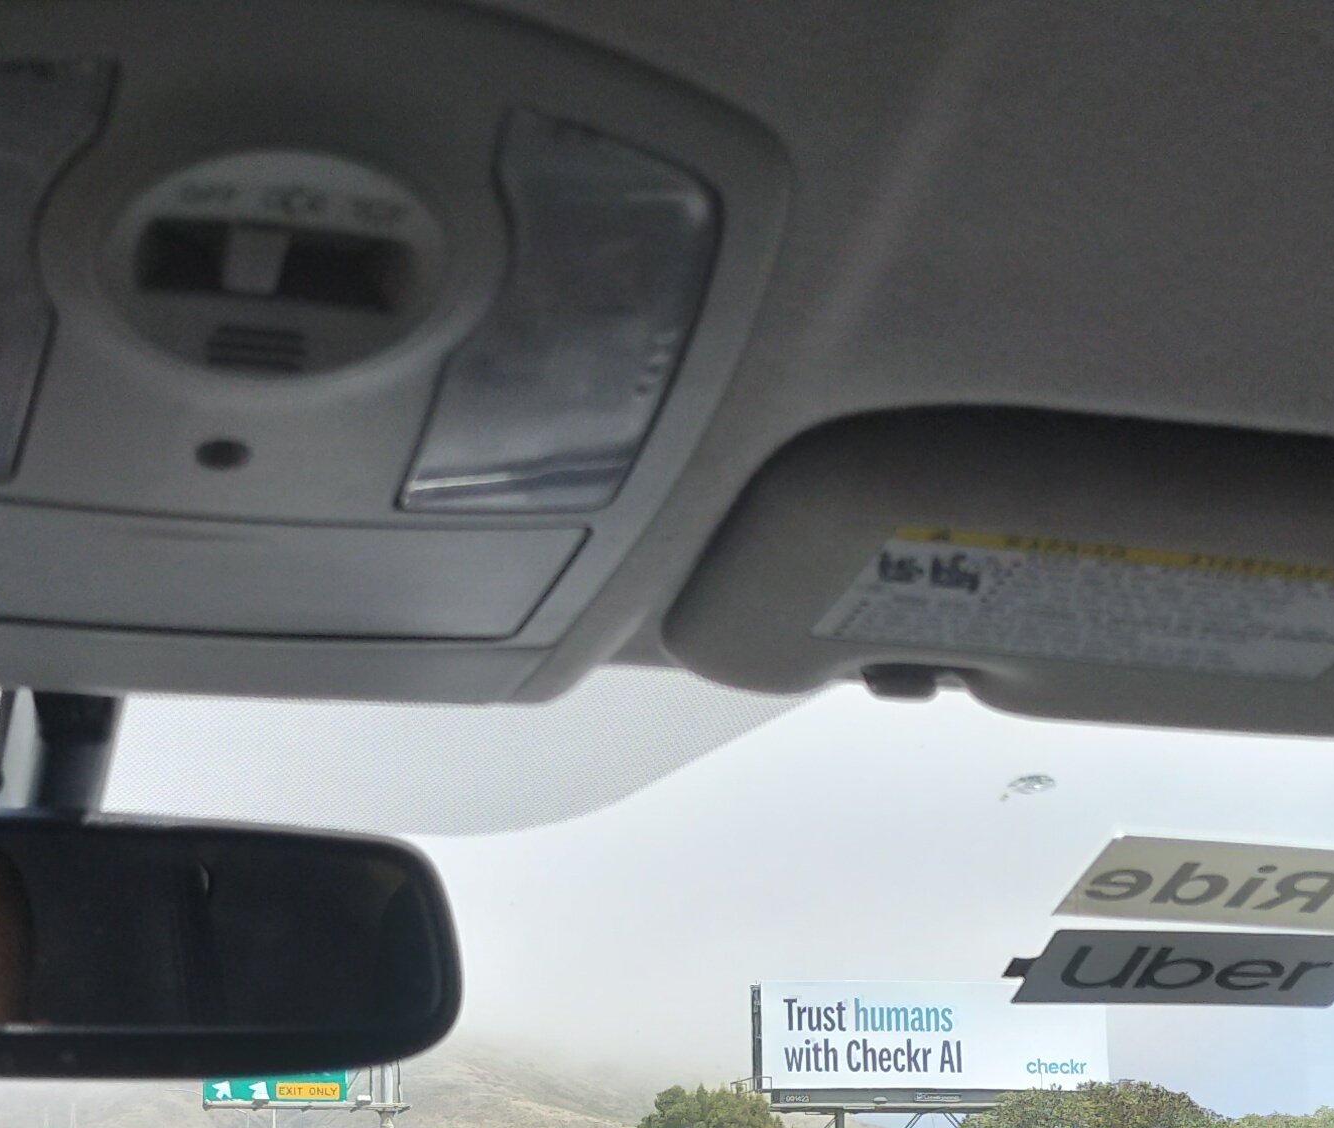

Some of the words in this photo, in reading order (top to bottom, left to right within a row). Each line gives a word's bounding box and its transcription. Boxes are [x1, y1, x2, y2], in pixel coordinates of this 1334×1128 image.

[1060, 945, 1334, 992] Uber
[783, 998, 847, 1032] Trust
[854, 997, 953, 1032] humans
[784, 1038, 838, 1072] with
[846, 1038, 931, 1073] Checkr
[939, 1040, 963, 1073] AI
[1026, 1058, 1087, 1075] checkr
[278, 1086, 303, 1097] EXIT
[309, 1087, 339, 1097] ONLY
